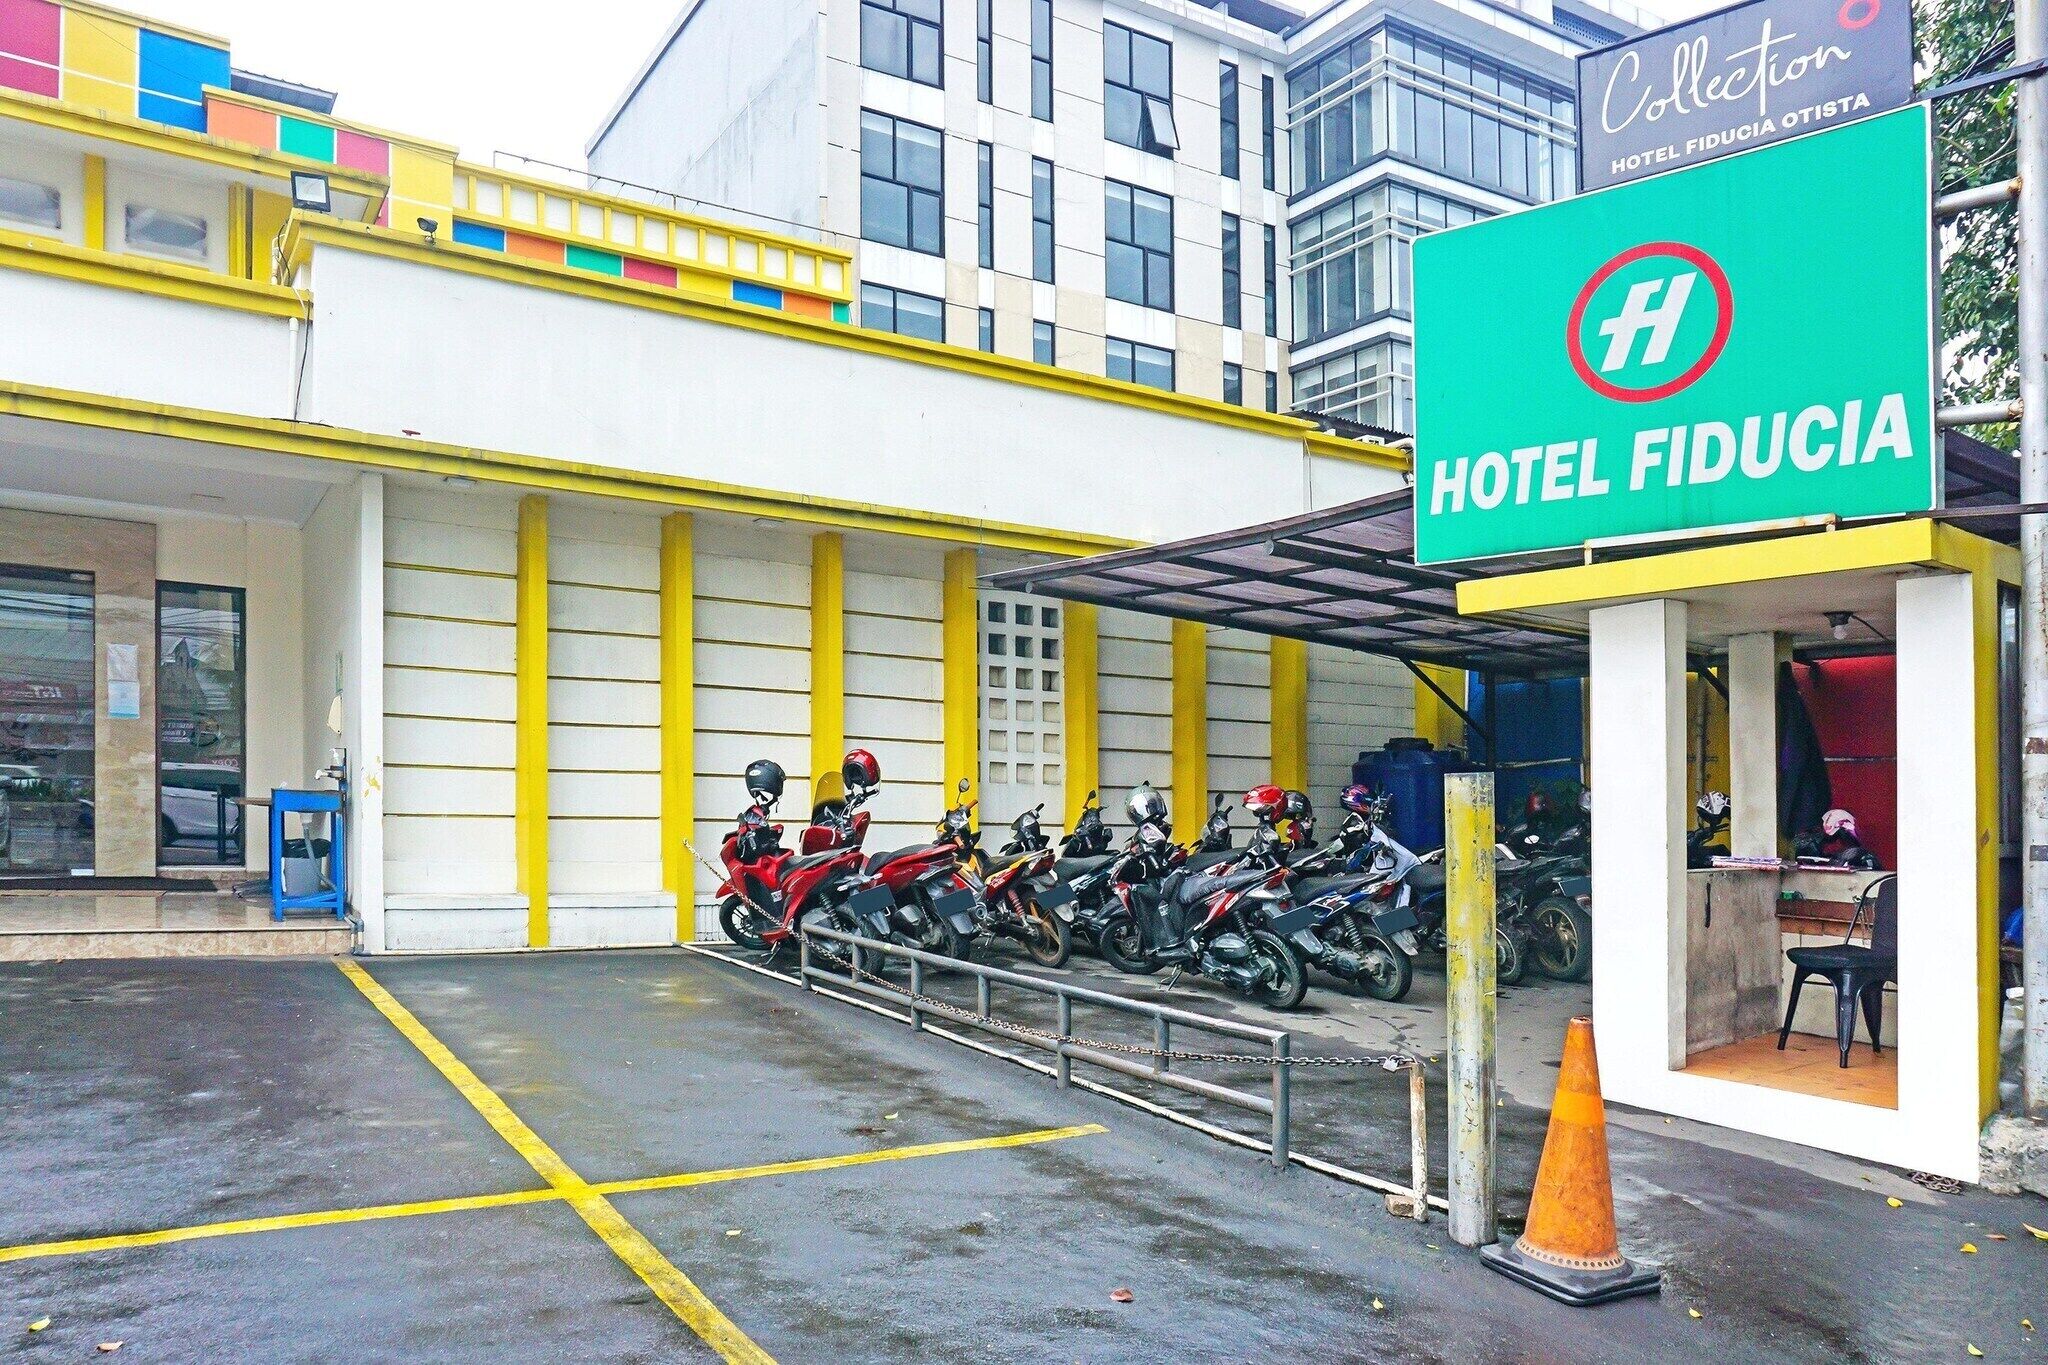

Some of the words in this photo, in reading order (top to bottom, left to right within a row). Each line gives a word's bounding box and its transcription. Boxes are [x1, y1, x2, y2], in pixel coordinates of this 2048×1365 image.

[1601, 18, 1852, 134] Collection
[1611, 148, 1681, 175] HOTEL
[1686, 118, 1776, 155] FIDUCIA
[1781, 92, 1871, 129] OTISTA
[1429, 437, 1610, 517] HOTEL
[1629, 392, 1914, 492] FIDUCIA
